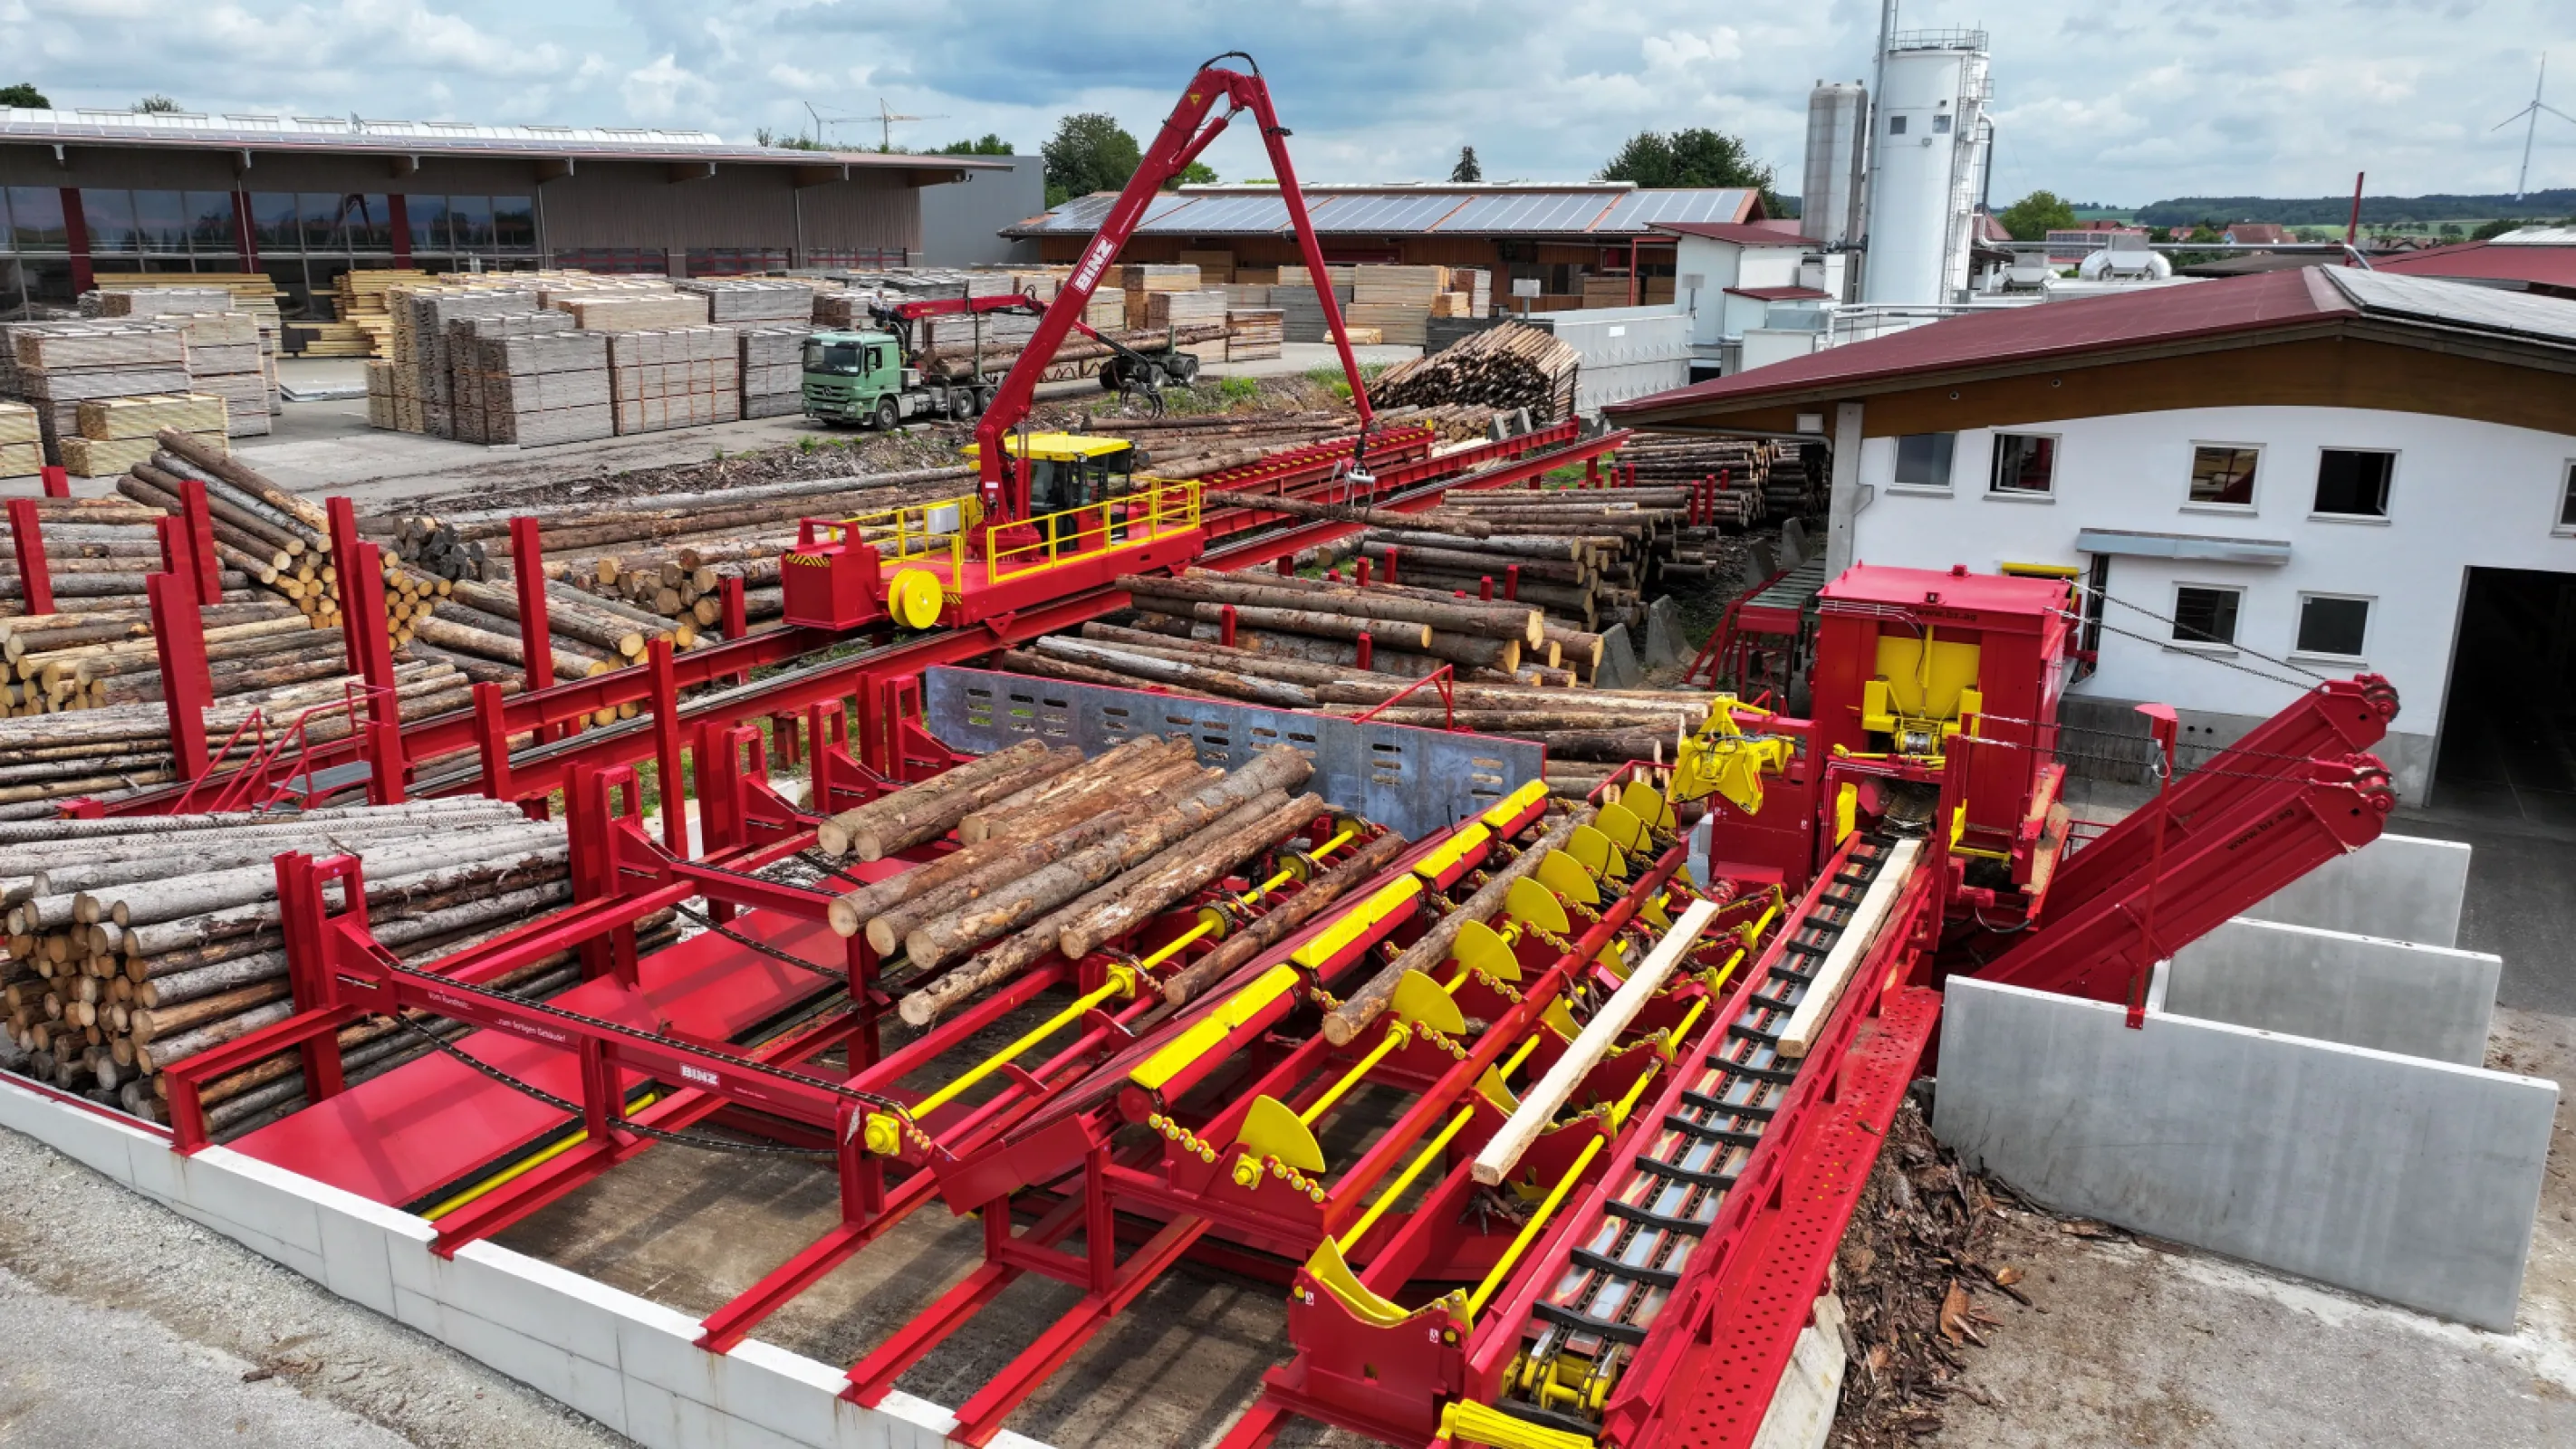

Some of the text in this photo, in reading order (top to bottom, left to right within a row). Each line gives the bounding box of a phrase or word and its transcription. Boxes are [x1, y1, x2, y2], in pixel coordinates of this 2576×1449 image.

[1074, 239, 1113, 292] BINZ
[1915, 609, 1978, 622] www.bz.ag
[2226, 809, 2294, 850] www.bz.ag
[681, 1065, 717, 1085] BINZ
